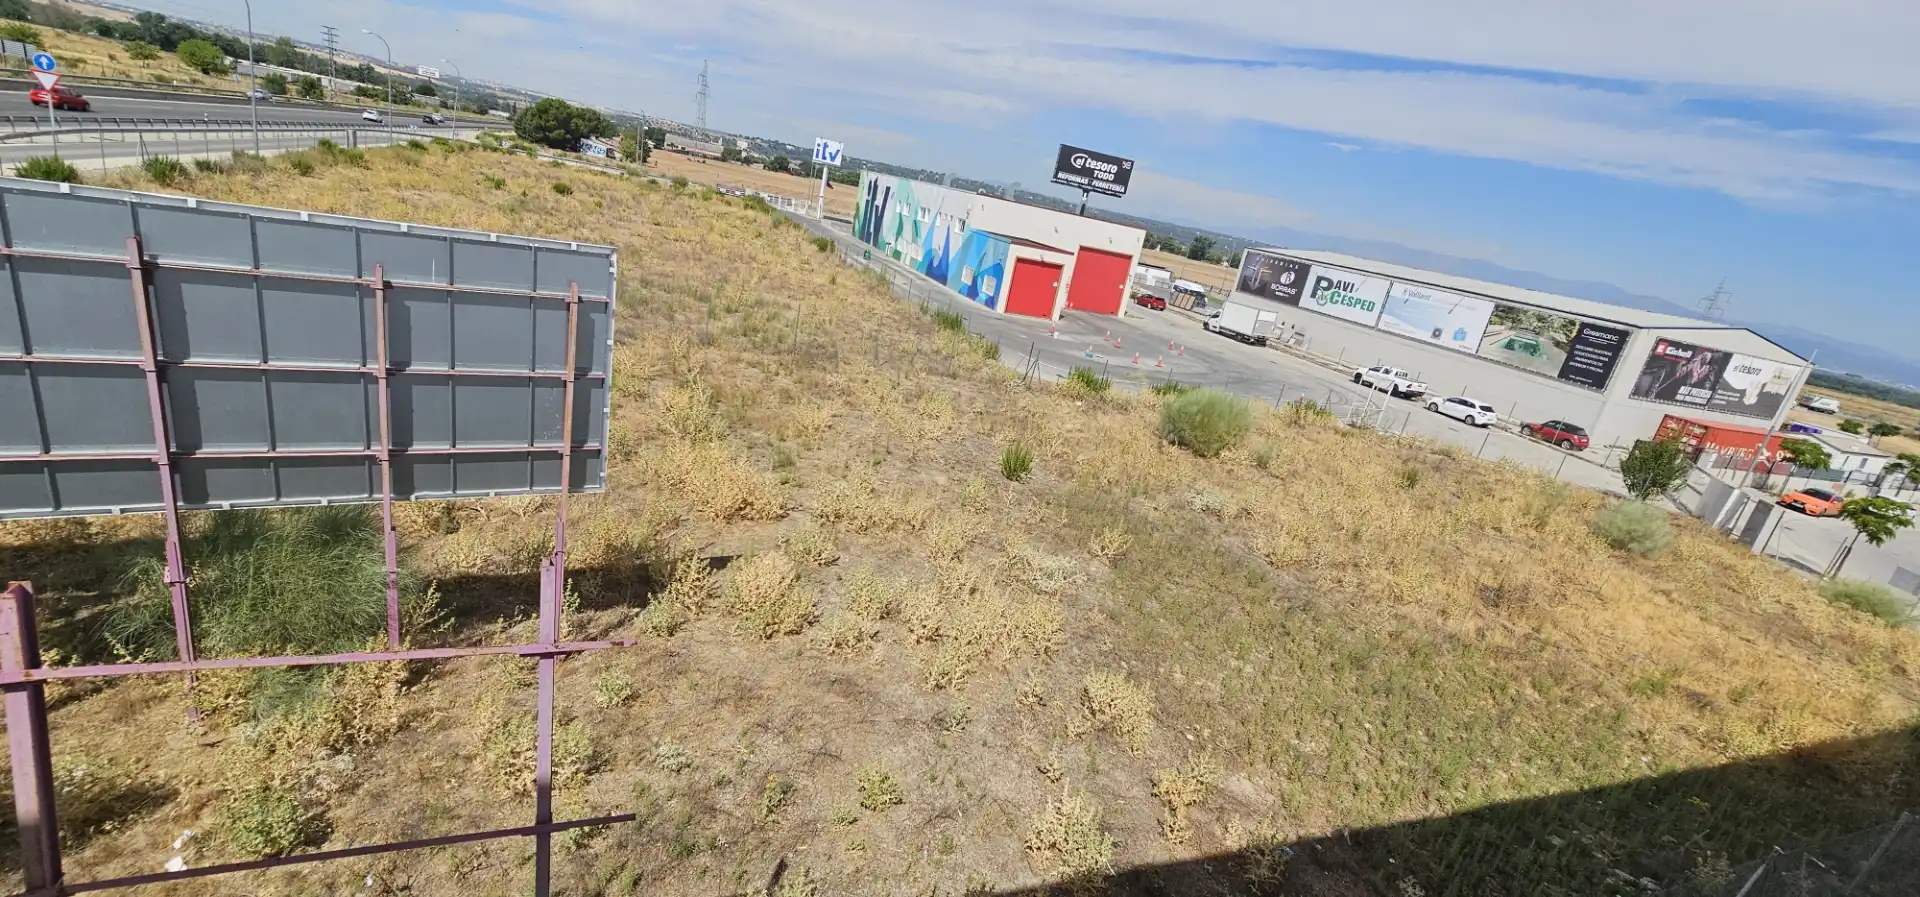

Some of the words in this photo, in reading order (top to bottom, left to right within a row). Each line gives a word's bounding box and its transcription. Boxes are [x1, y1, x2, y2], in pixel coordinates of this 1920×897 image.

[815, 142, 841, 163] itv
[1085, 157, 1119, 174] tesoro
[1093, 169, 1115, 182] TODO
[1739, 364, 1762, 376] tesoro
